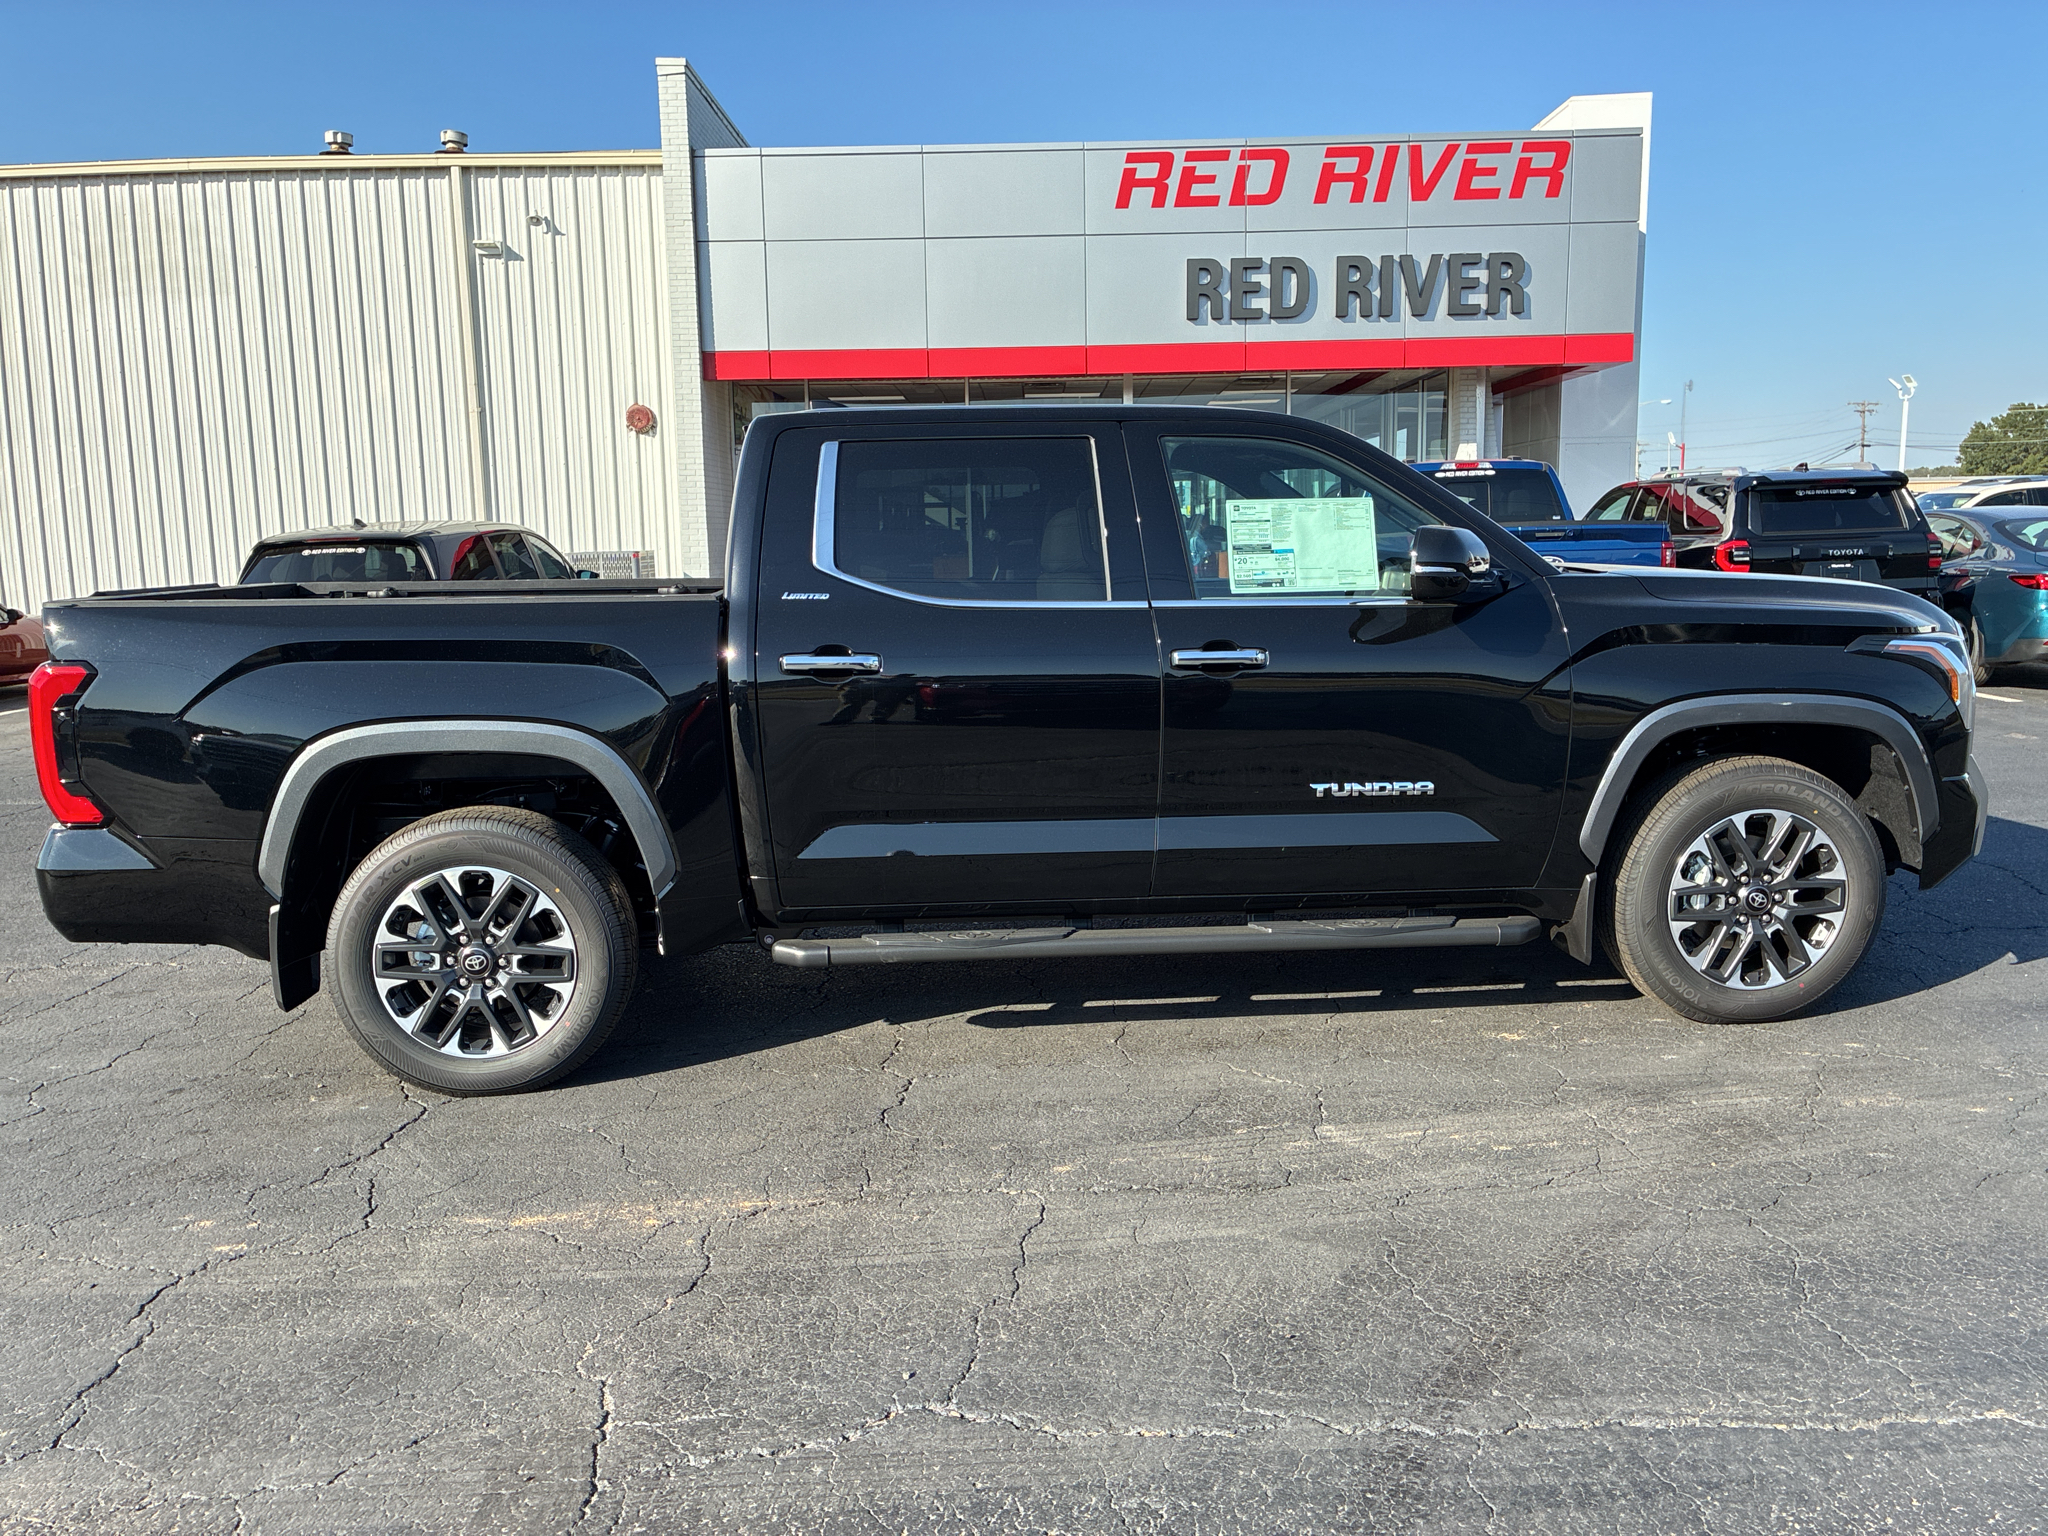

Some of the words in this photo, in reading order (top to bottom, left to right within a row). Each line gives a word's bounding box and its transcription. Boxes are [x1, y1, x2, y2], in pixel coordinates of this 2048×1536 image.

[1114, 148, 1290, 209] RED
[1313, 140, 1572, 204] RIVER
[1186, 256, 1311, 320] RED
[1335, 252, 1526, 317] RIVER
[1237, 557, 1248, 565] 20
[1828, 548, 1864, 556] TOYOTA
[781, 591, 830, 600] LIMITED
[1309, 780, 1435, 798] TUNDRA
[1648, 939, 1702, 1005] YOKOHAMA
[547, 987, 604, 1063] YOKOHAMA
